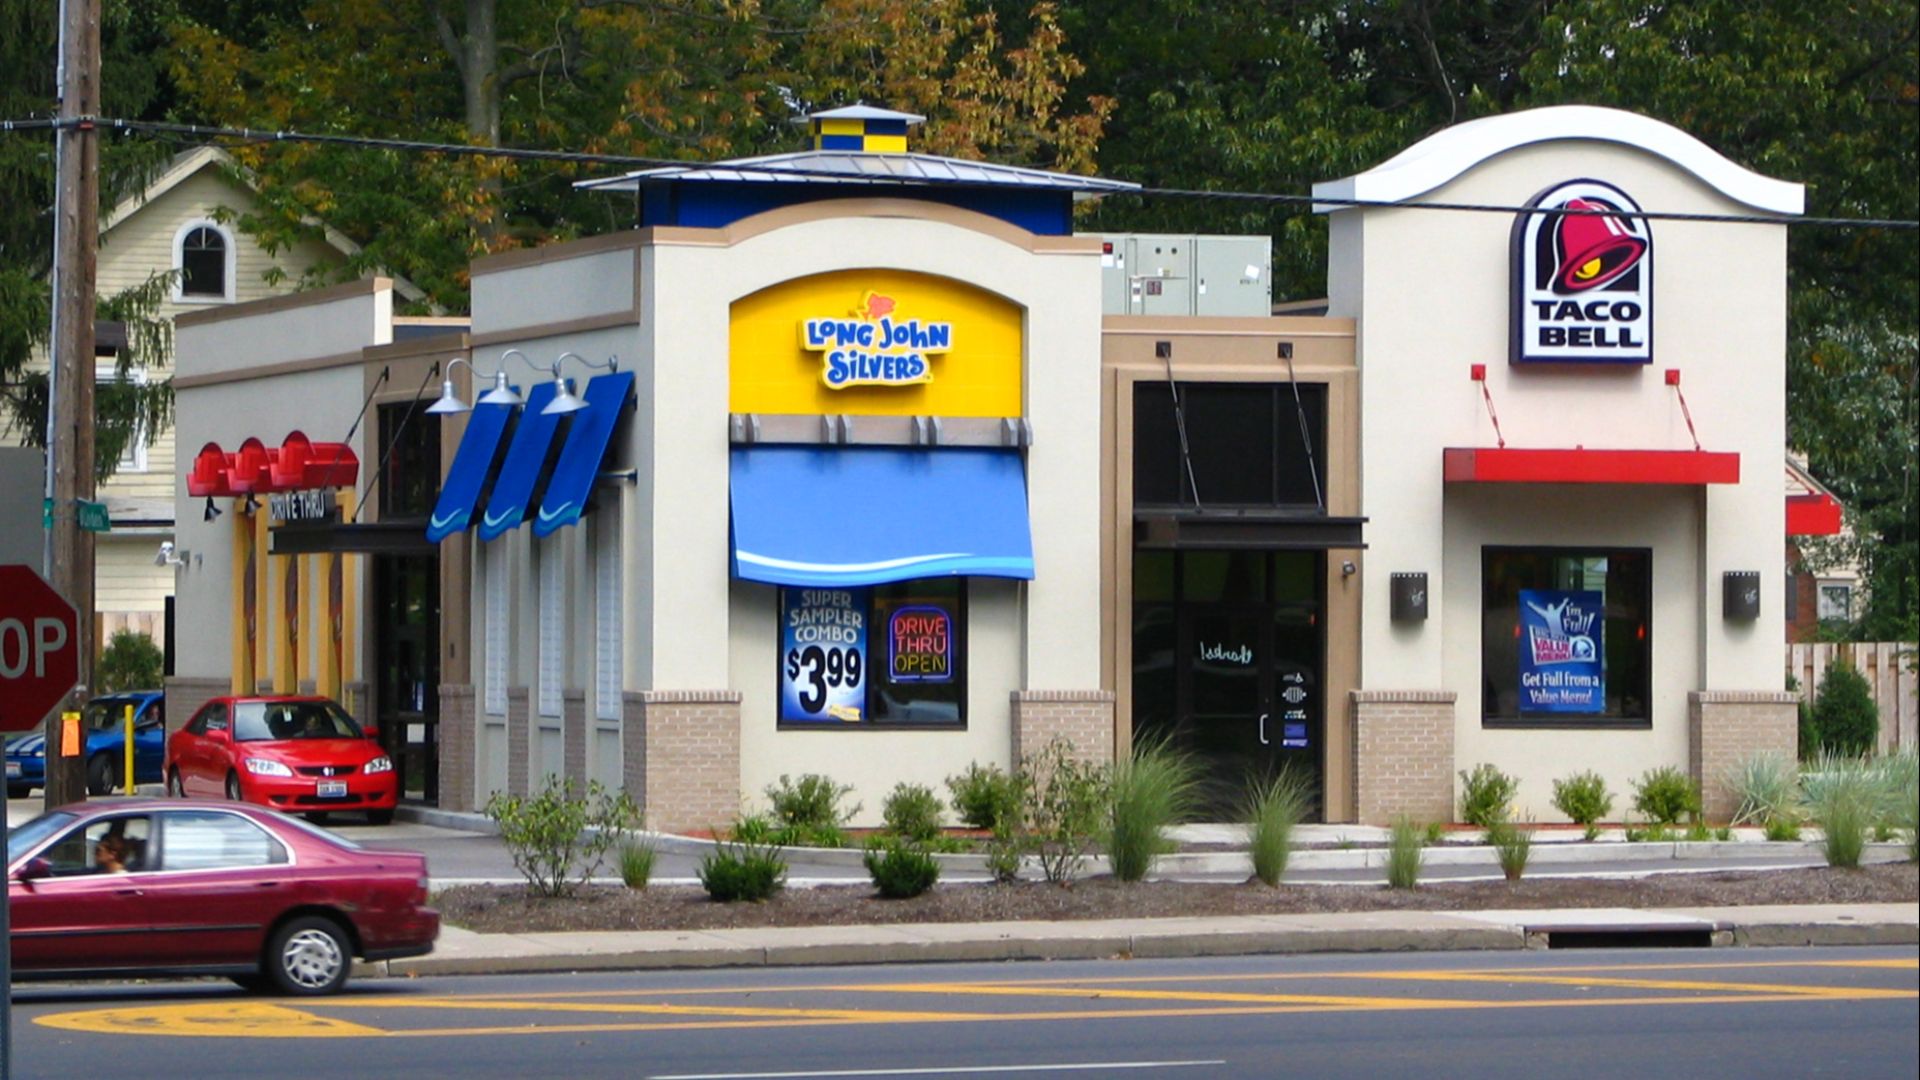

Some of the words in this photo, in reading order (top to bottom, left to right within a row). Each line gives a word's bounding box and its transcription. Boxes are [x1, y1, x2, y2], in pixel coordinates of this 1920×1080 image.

[1531, 301, 1641, 322] TACO
[808, 321, 874, 346] LONG
[1538, 326, 1643, 347] BELL
[299, 491, 324, 519] THRU
[801, 589, 852, 608] SUPER
[790, 608, 862, 629] SAMPLER
[894, 617, 945, 635] DRIVE
[795, 625, 857, 644] COMBO
[0, 617, 67, 679] OP
[896, 636, 946, 654] THRU
[1534, 638, 1569, 651] VALUE
[894, 654, 946, 672] OPEN
[1522, 672, 1540, 687] Get
[1542, 671, 1563, 687] Full
[1564, 671, 1591, 687] from
[1592, 676, 1600, 688] a
[1529, 688, 1558, 704] Value
